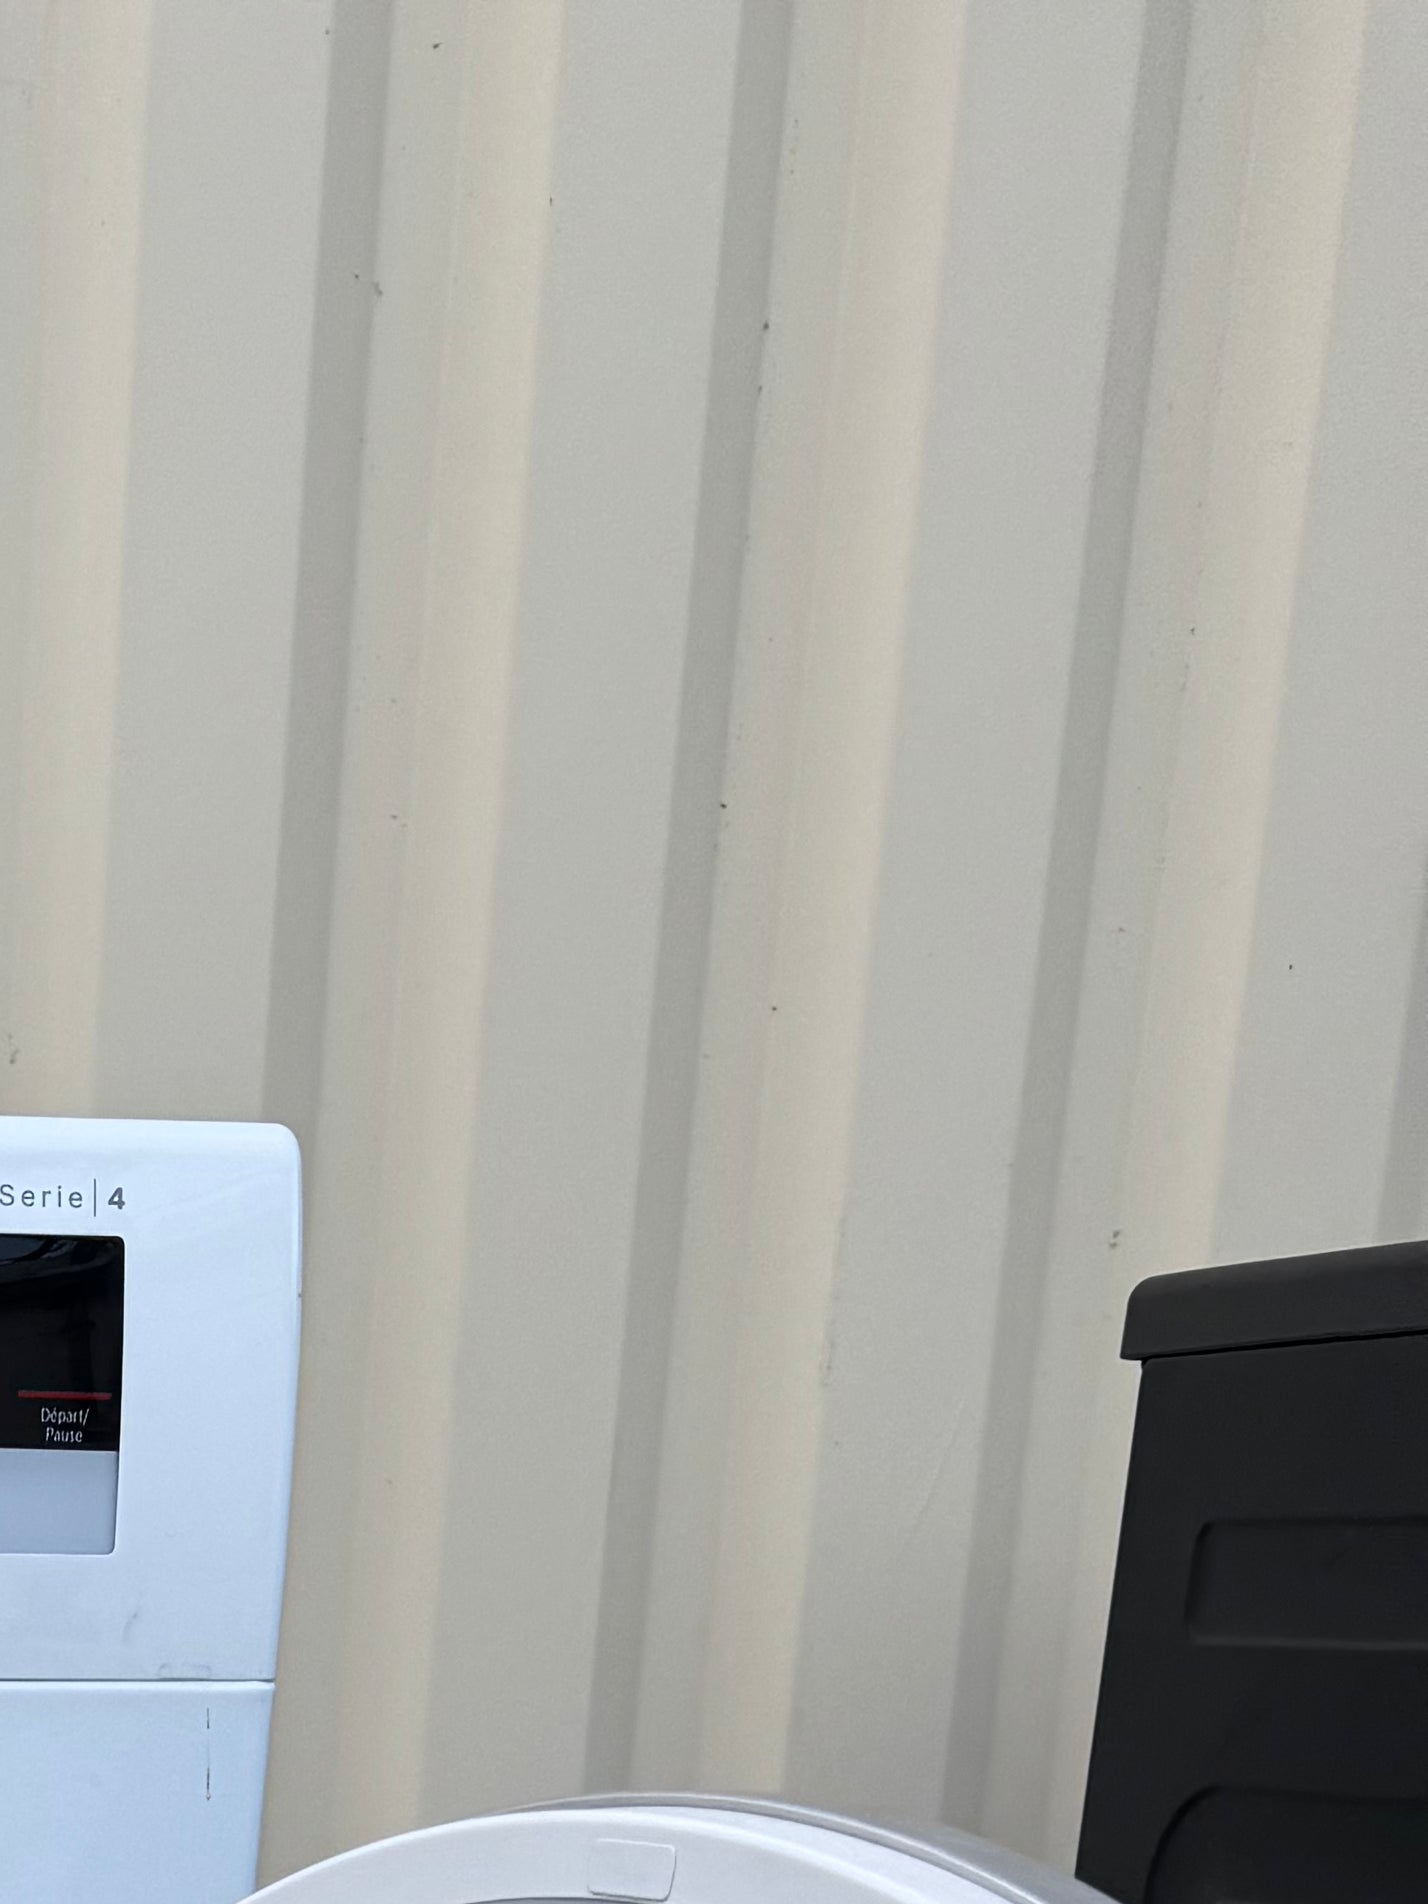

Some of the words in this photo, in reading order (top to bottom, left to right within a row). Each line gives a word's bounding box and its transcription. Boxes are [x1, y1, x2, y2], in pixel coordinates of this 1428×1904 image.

[0, 1183, 83, 1208] Serie
[107, 1187, 126, 1210] 4
[45, 1427, 84, 1443] Pause
